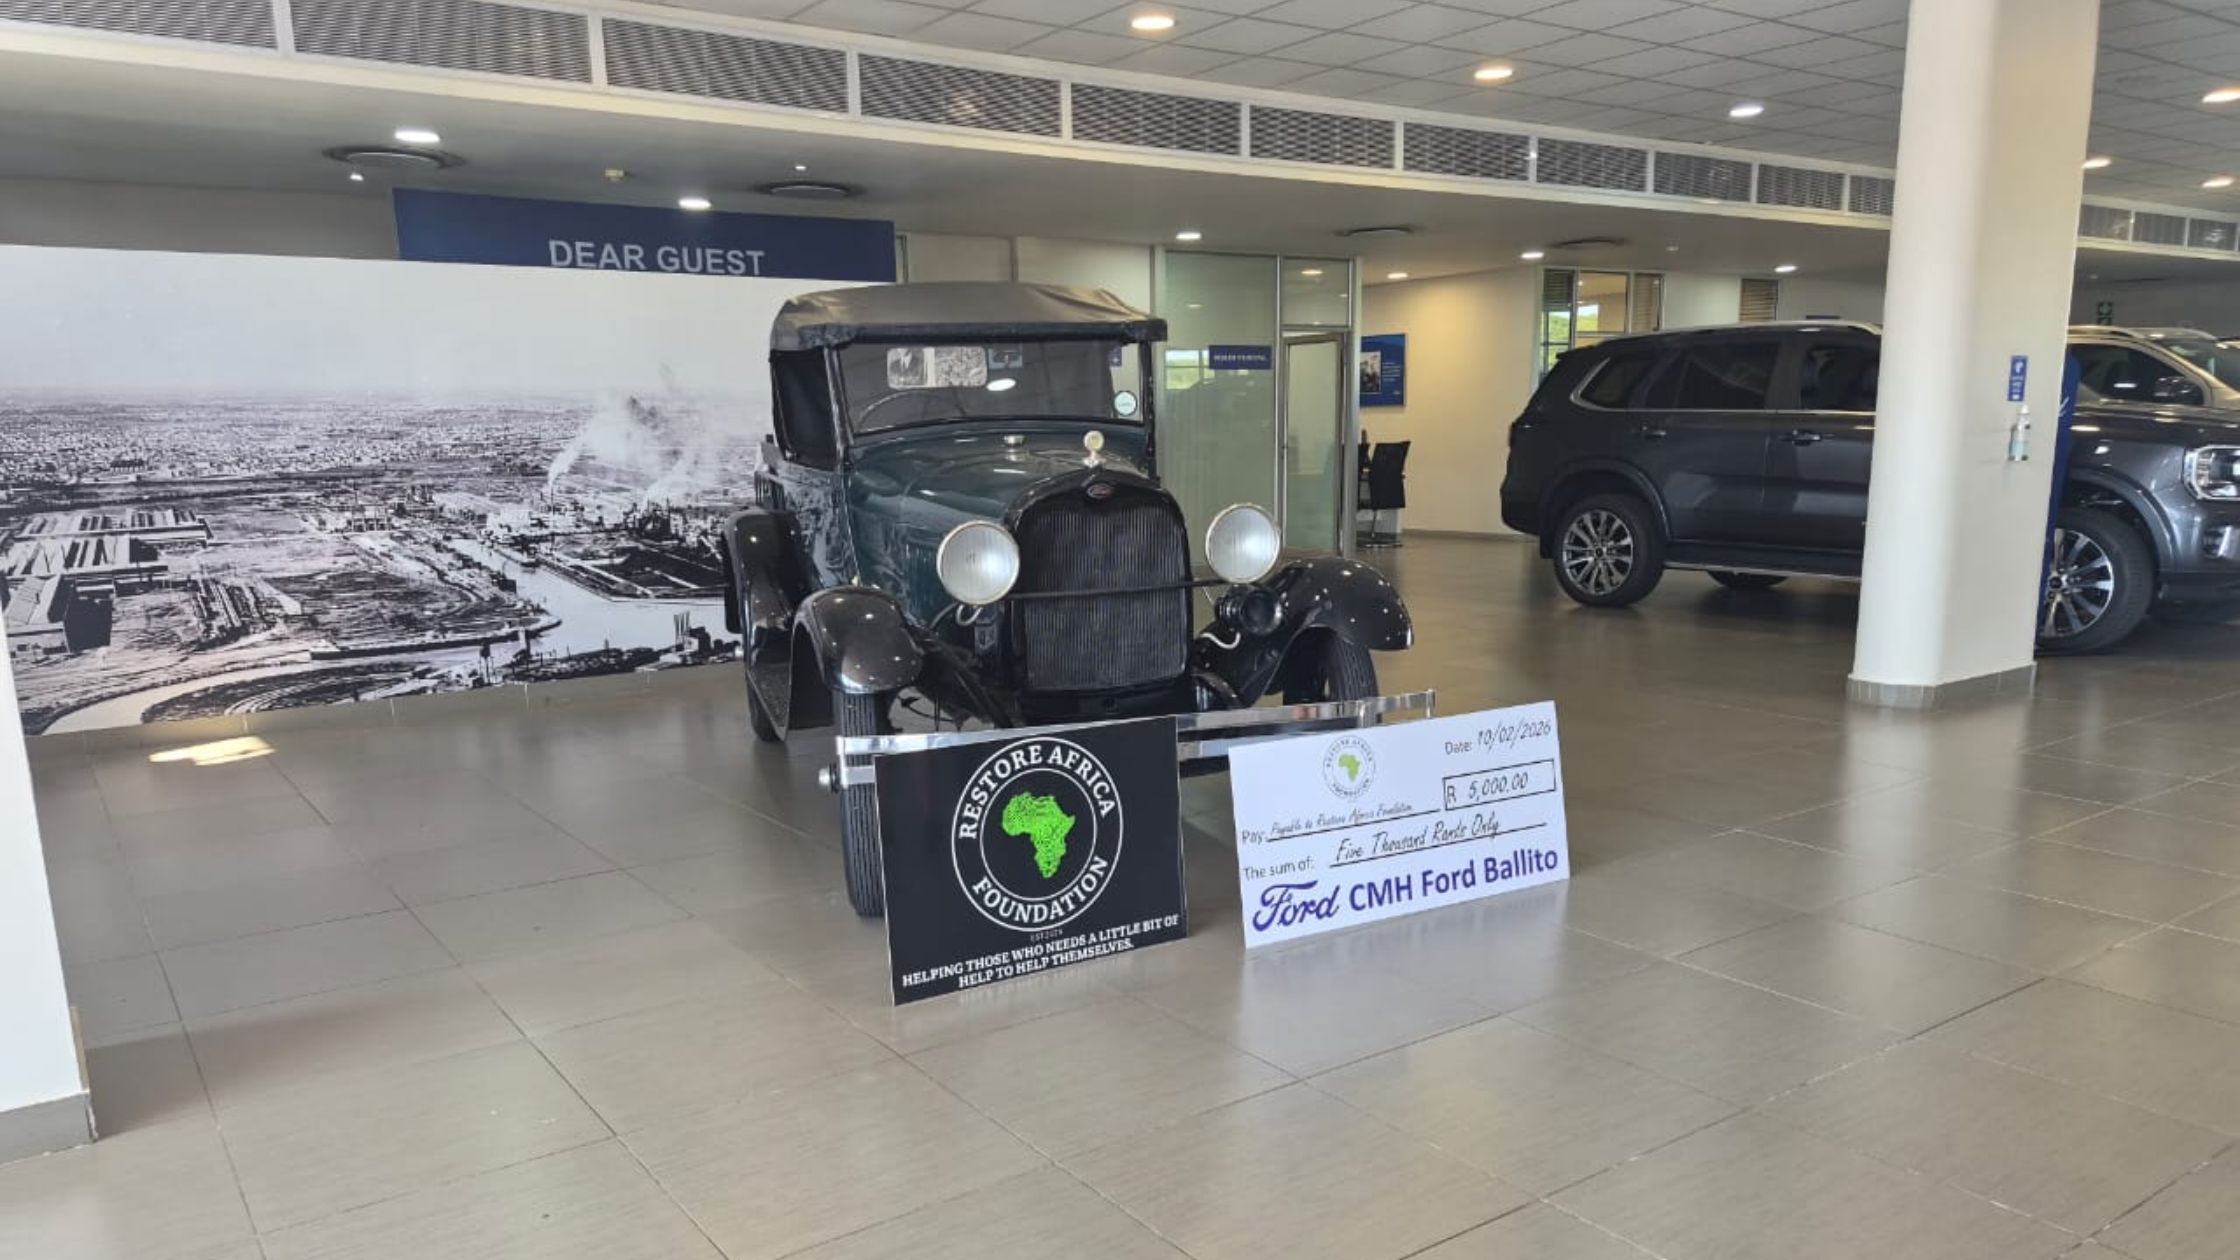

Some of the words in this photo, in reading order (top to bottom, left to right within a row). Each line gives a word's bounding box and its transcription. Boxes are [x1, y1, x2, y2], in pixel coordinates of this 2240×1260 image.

[549, 240, 648, 270] DEAR
[657, 246, 765, 275] GUEST
[1444, 741, 1473, 755] Date:
[960, 744, 1042, 839] RESTORE
[1047, 745, 1116, 818] AFRICA
[1446, 785, 1457, 803] R
[1469, 772, 1529, 802] 5,000.00
[1243, 867, 1266, 881] The
[1269, 863, 1296, 876] sum
[1298, 855, 1315, 871] of:
[1336, 837, 1363, 862] Five
[1372, 824, 1428, 854] Thousand
[1432, 818, 1468, 843] Rands
[1471, 811, 1499, 841] Only
[972, 854, 1109, 924] FOUNDATION
[1253, 880, 1340, 931] Ford
[1350, 874, 1413, 911] CMH
[1422, 860, 1476, 897] Ford
[1484, 848, 1558, 883] Ballito
[902, 962, 964, 988] HELPING
[965, 951, 1010, 973] THOSE
[1011, 944, 1045, 961] WHO
[1046, 934, 1087, 954] NEEDS
[1088, 932, 1097, 945] A
[1099, 922, 1140, 942] LITTLE
[1142, 918, 1162, 933] BIT
[1164, 914, 1179, 928] OF
[958, 969, 994, 989] HELP
[996, 965, 1014, 980] TO
[1016, 956, 1050, 975] HELP
